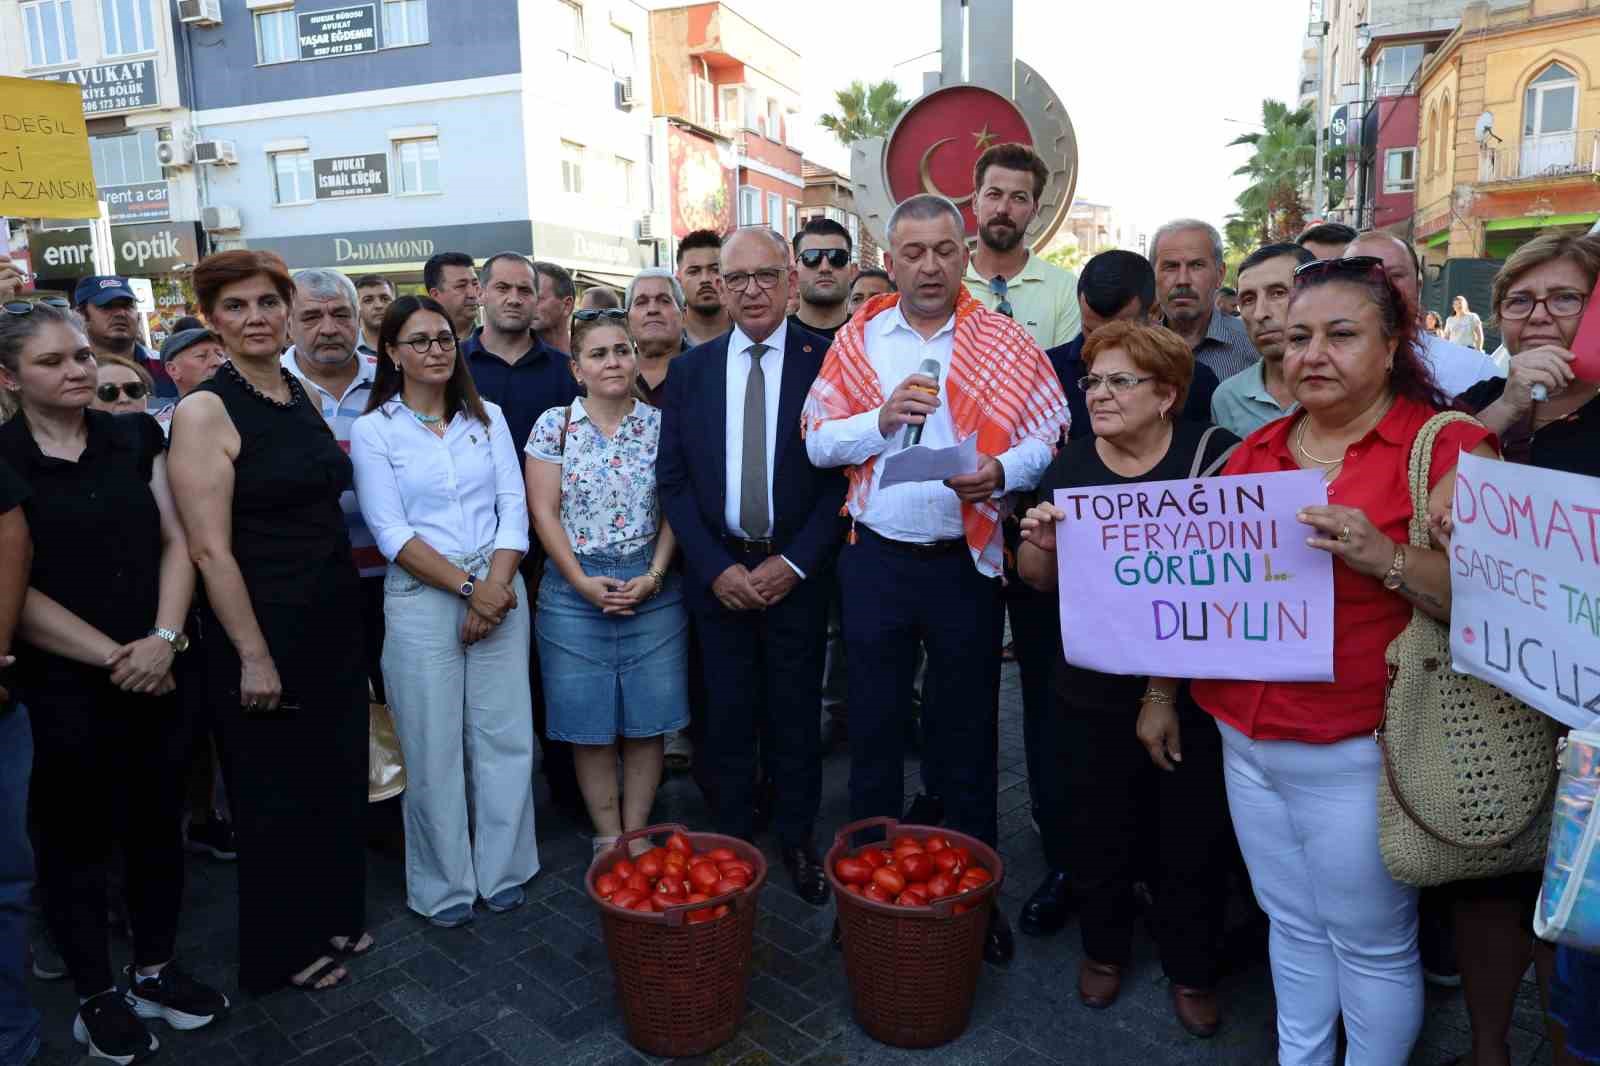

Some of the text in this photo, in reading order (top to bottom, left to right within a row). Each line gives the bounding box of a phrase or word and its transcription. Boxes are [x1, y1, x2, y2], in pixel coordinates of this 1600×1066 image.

[321, 20, 351, 31] AVUKAT
[300, 34, 329, 48] YAŞAR
[66, 62, 145, 86] AVUKAT
[109, 81, 144, 98] BÖLÜK
[332, 157, 366, 172] AVUKAT
[106, 189, 134, 204] rent
[136, 190, 144, 201] a
[121, 231, 182, 268] optik
[1067, 484, 1265, 521] TOPRAĞIN
[1101, 519, 1278, 552] FERYADINI
[1454, 545, 1548, 611] SADECE
[1151, 600, 1309, 642] DUYUN
